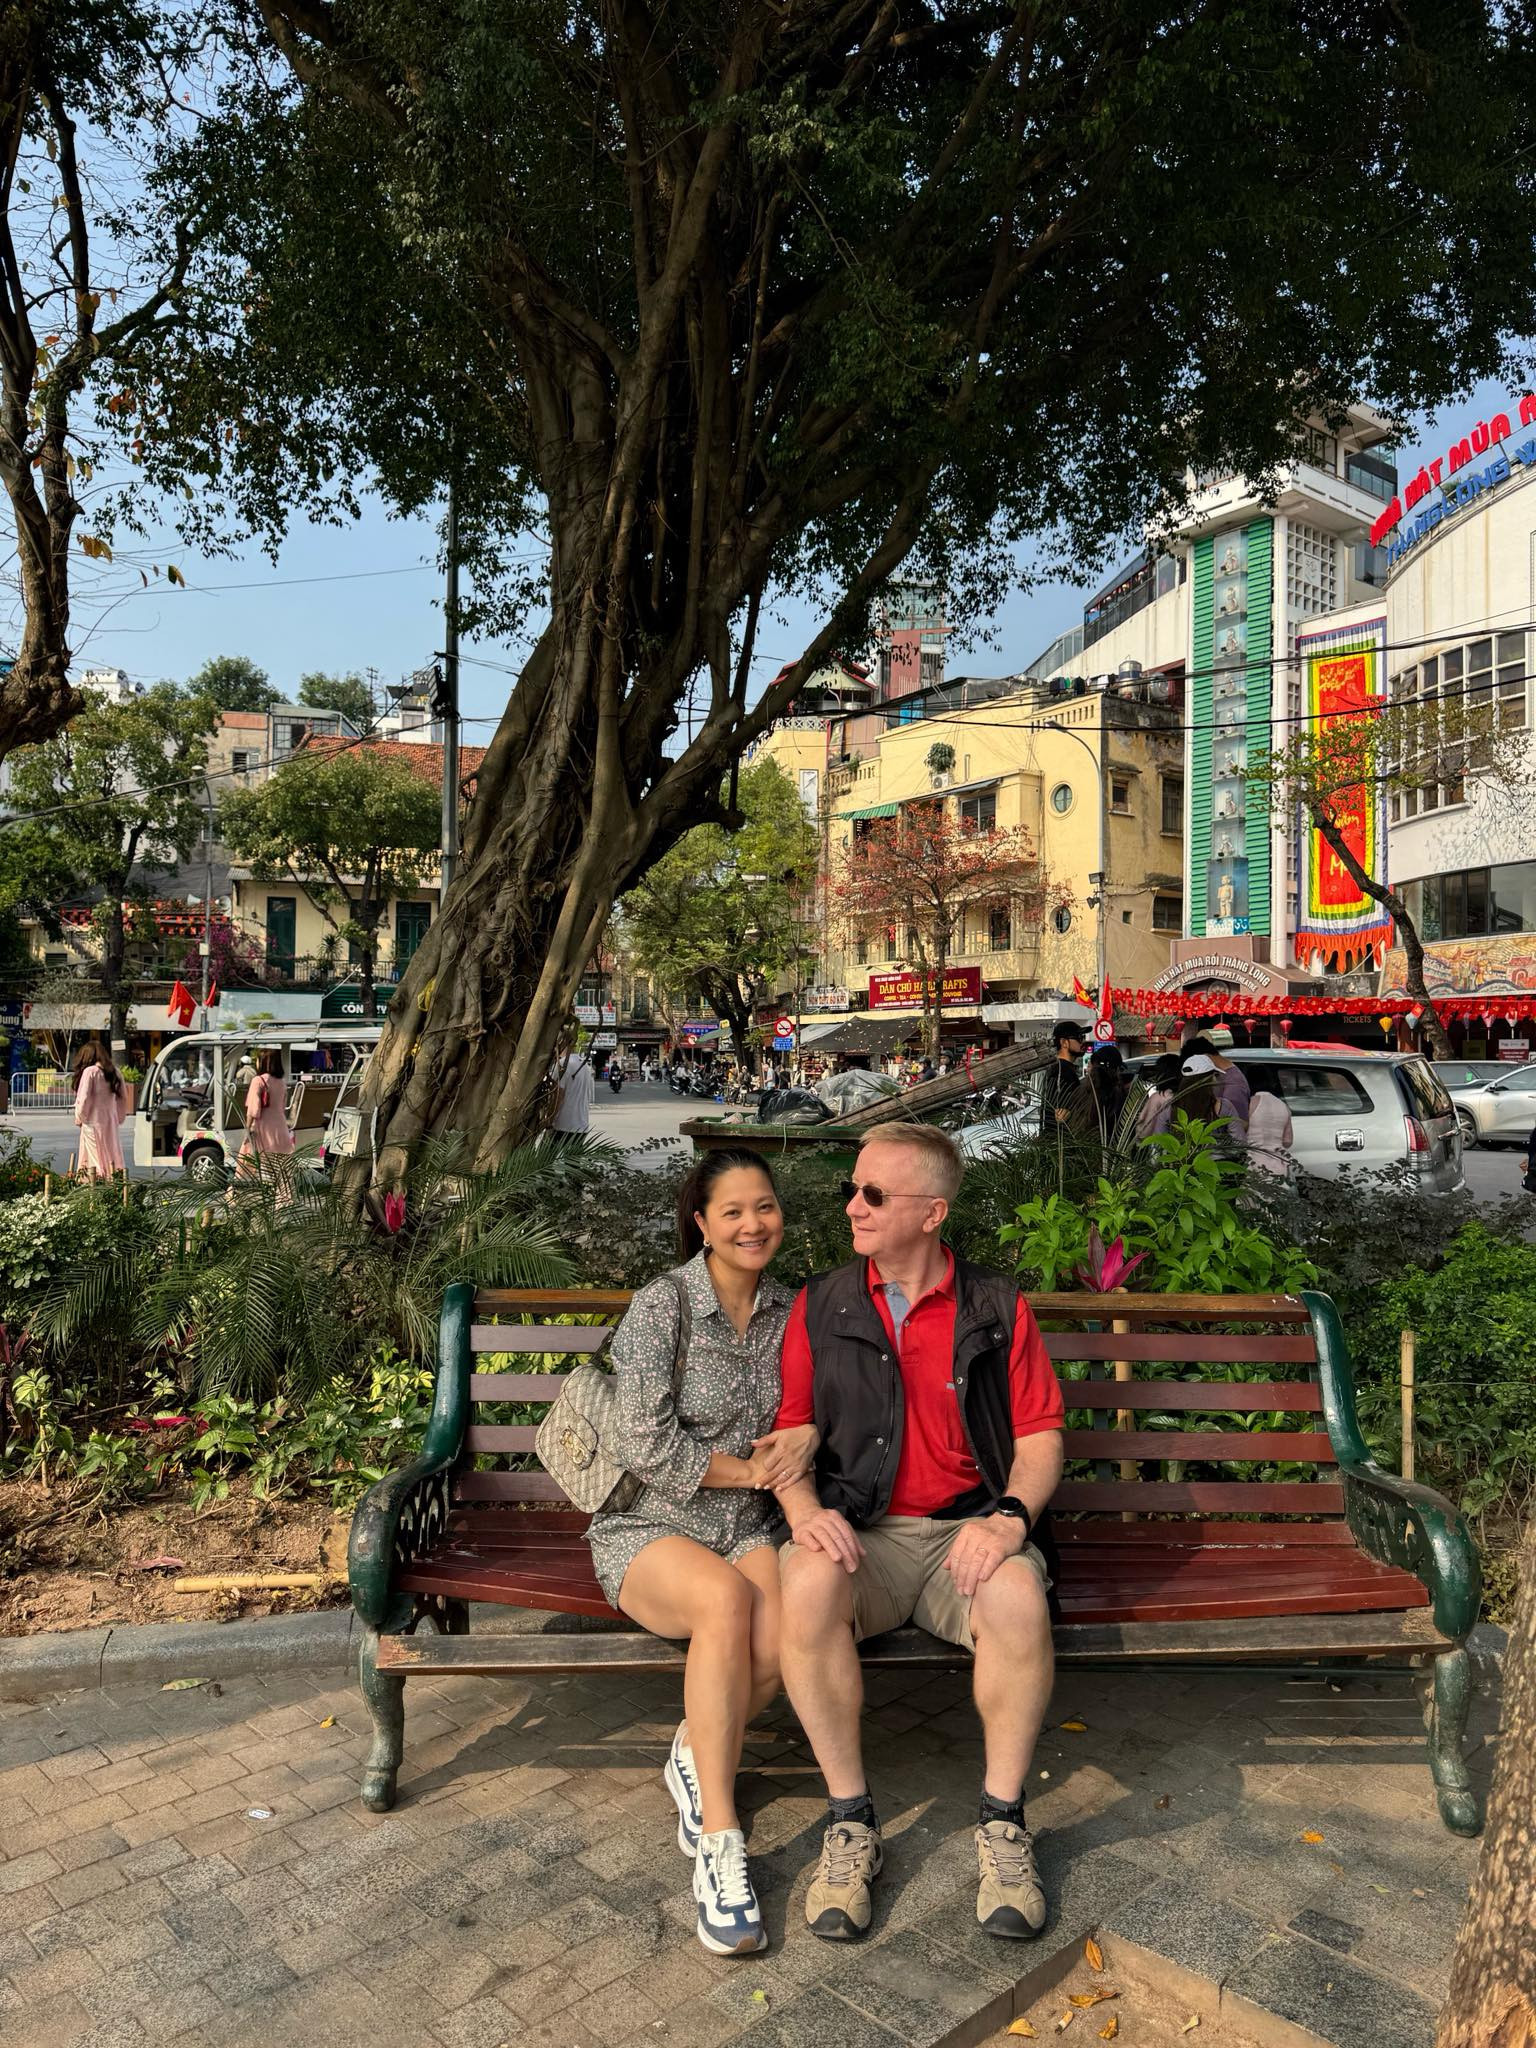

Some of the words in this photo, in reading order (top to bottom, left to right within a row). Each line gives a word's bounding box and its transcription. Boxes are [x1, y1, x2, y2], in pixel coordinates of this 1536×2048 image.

[1449, 412, 1512, 474] MÚA
[1248, 965, 1271, 988] LONG
[341, 1002, 364, 1014] CÔN
